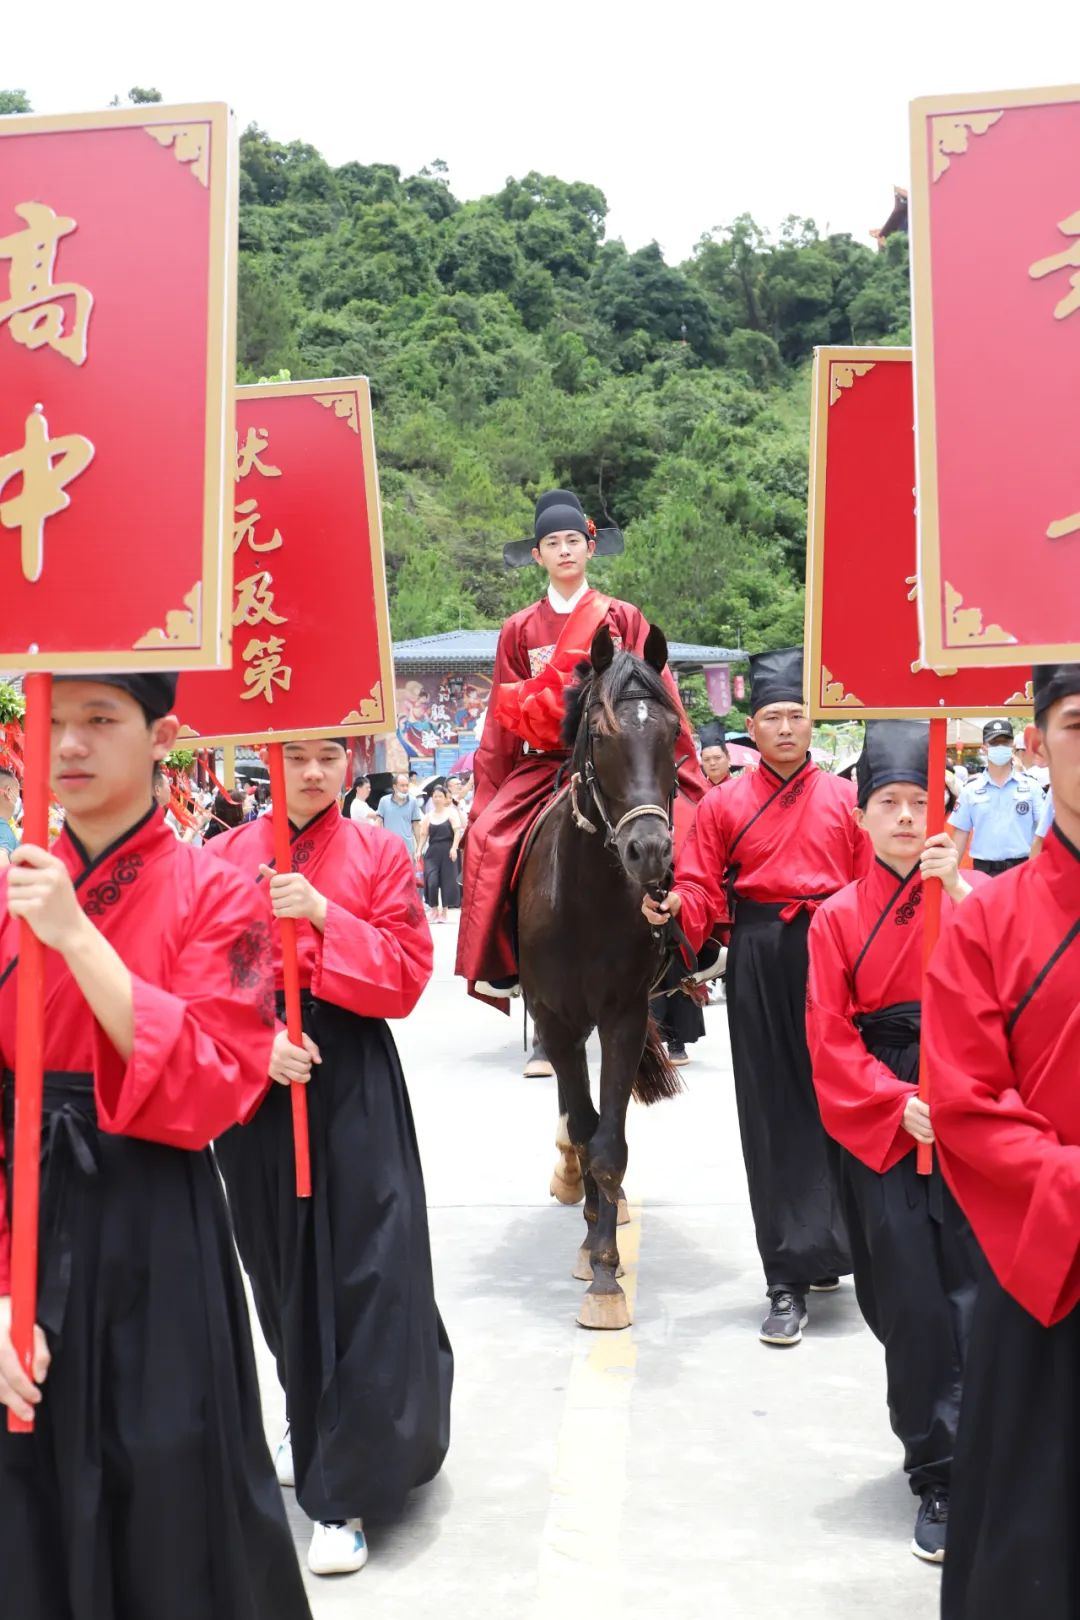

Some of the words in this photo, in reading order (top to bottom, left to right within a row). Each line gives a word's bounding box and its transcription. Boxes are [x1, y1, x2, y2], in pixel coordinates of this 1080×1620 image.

[0, 201, 94, 582] 高中
[232, 427, 292, 704] 状元及第
